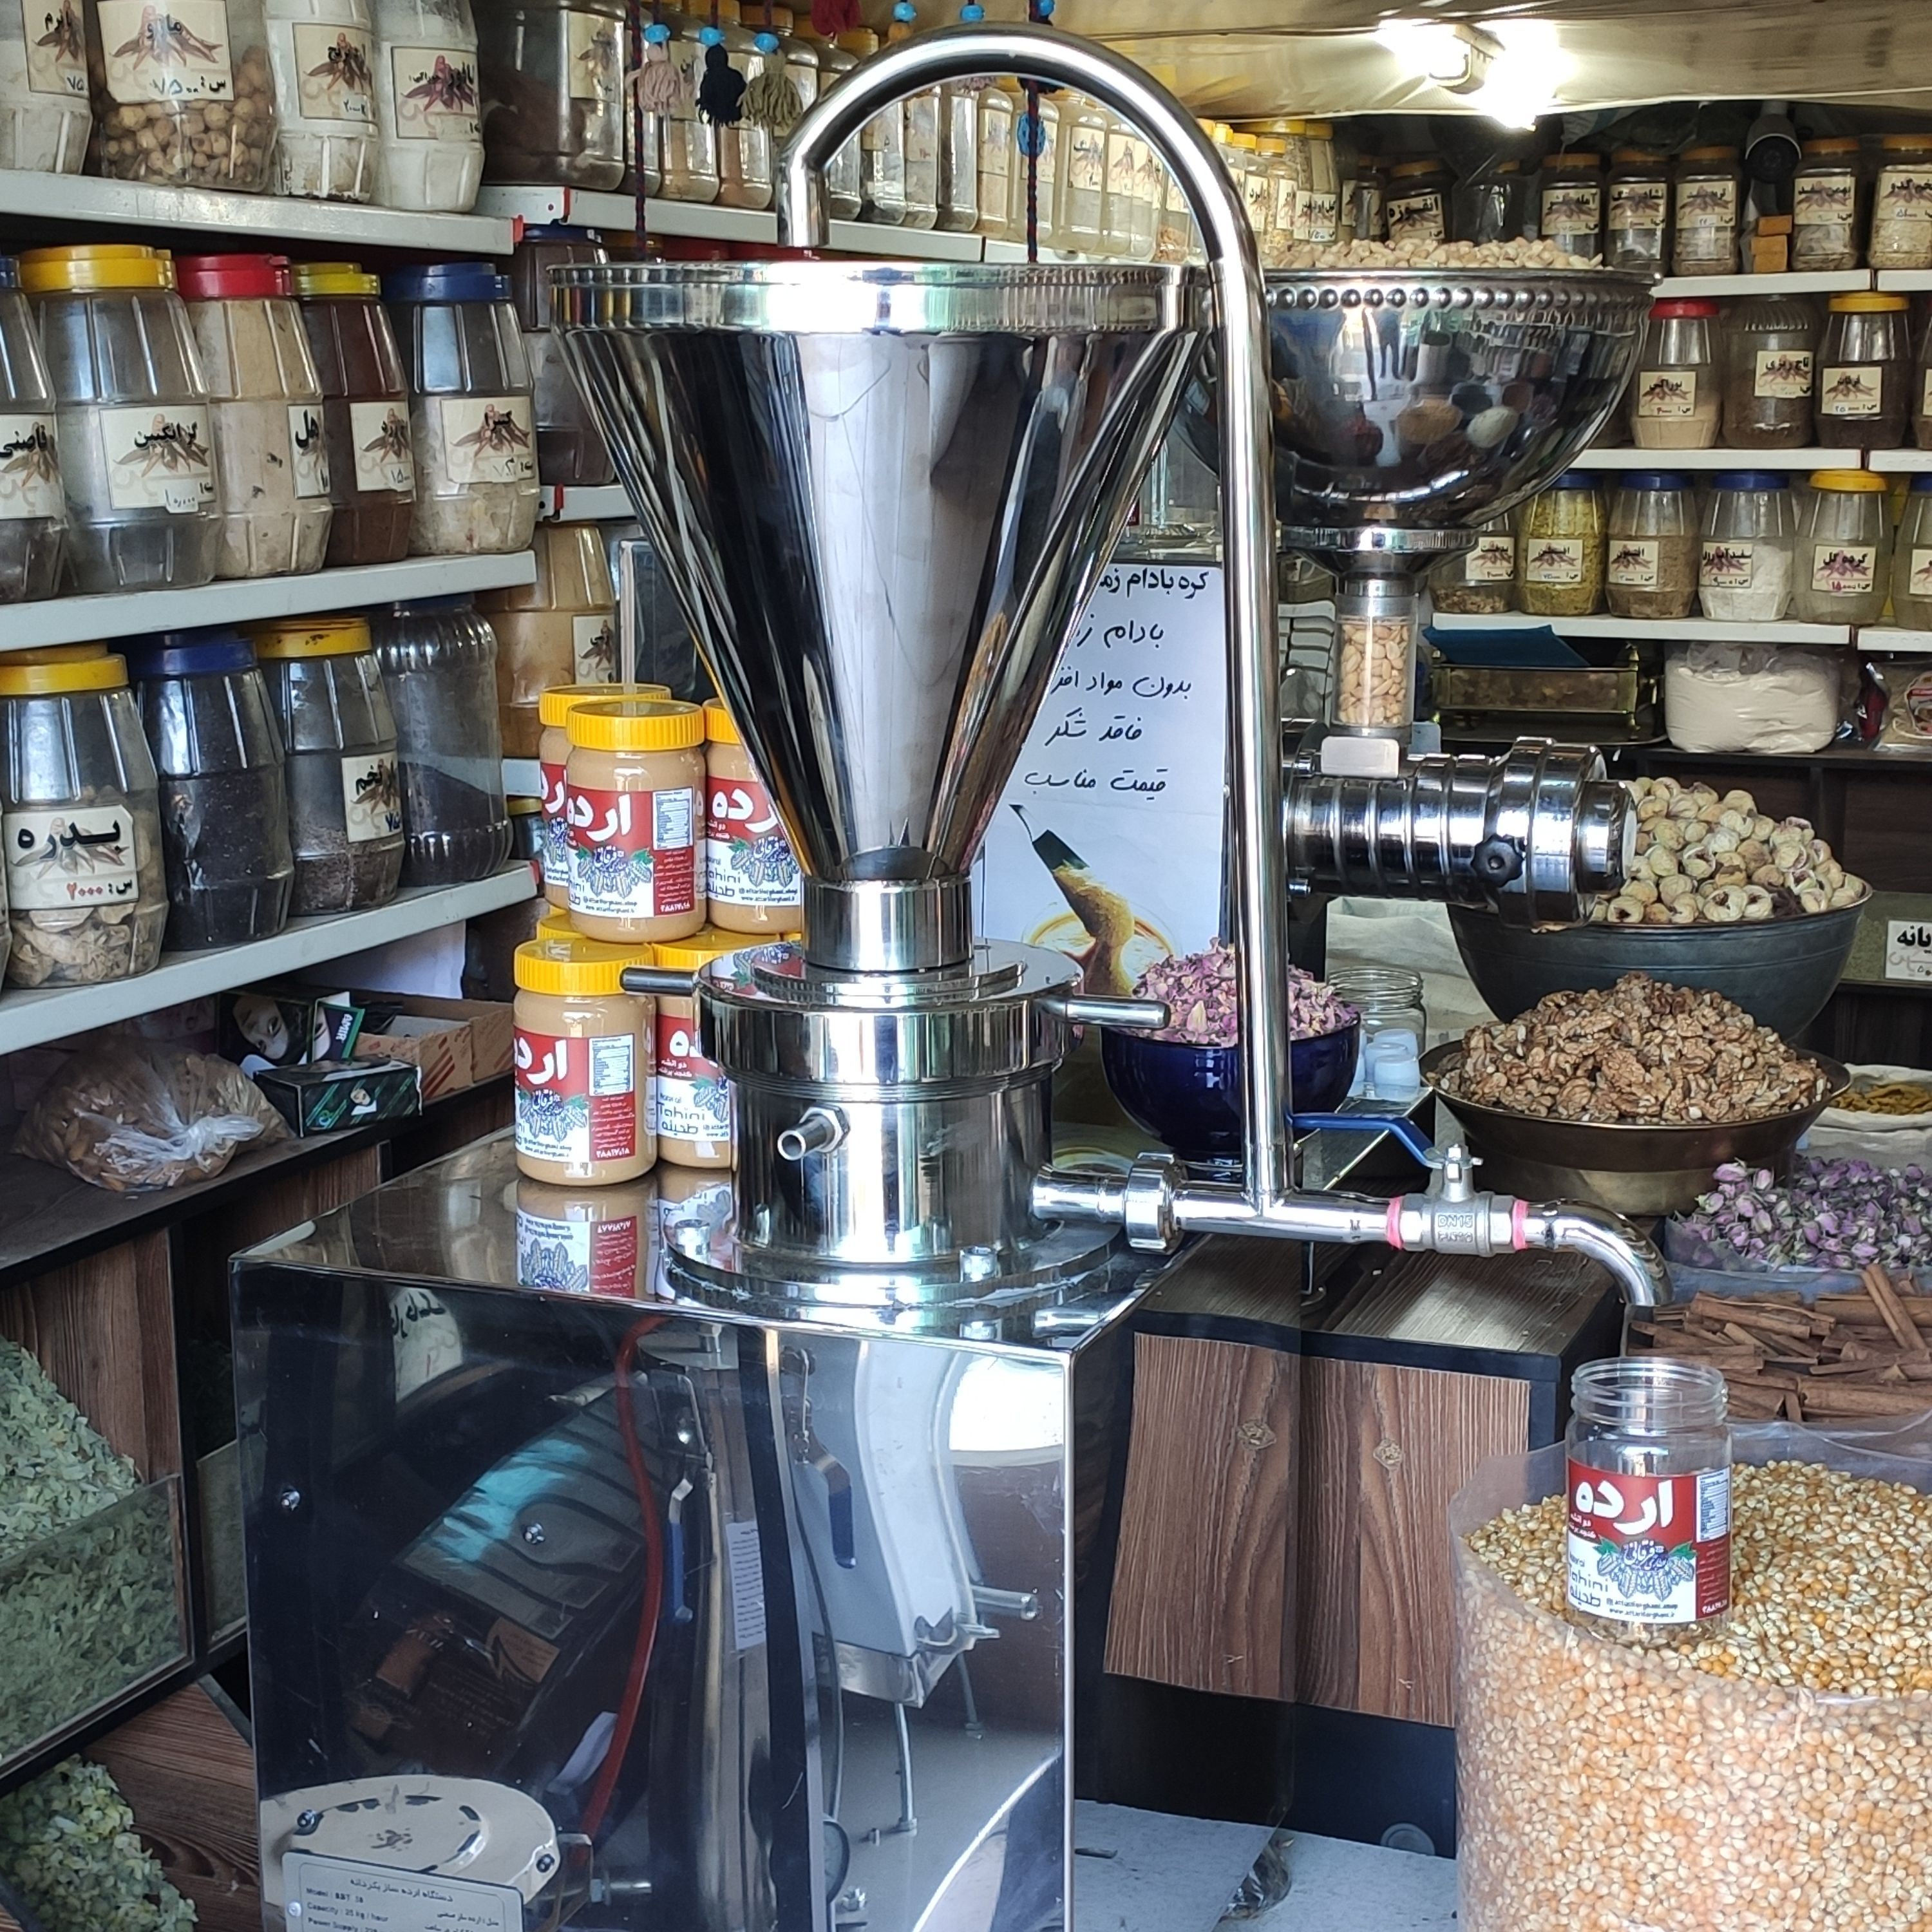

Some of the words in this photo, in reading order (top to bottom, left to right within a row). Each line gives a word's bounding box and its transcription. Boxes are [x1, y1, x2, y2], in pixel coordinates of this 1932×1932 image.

[1099, 567, 1121, 592] زم
[1126, 567, 1174, 598] بادام
[1178, 571, 1209, 599] کره
[1103, 620, 1165, 648] بادام
[1050, 665, 1079, 695] افز
[1086, 672, 1122, 695] مواد
[1132, 676, 1192, 699] بدون
[1044, 707, 1088, 746] شکر
[1098, 715, 1142, 742] فاقد
[1024, 768, 1097, 795] مناسب
[1110, 768, 1168, 800] قیمت
[712, 788, 779, 833] رده
[656, 1101, 705, 1121] Tahini
[1437, 1214, 1473, 1228] DN15
[1575, 1479, 1673, 1535] ارده
